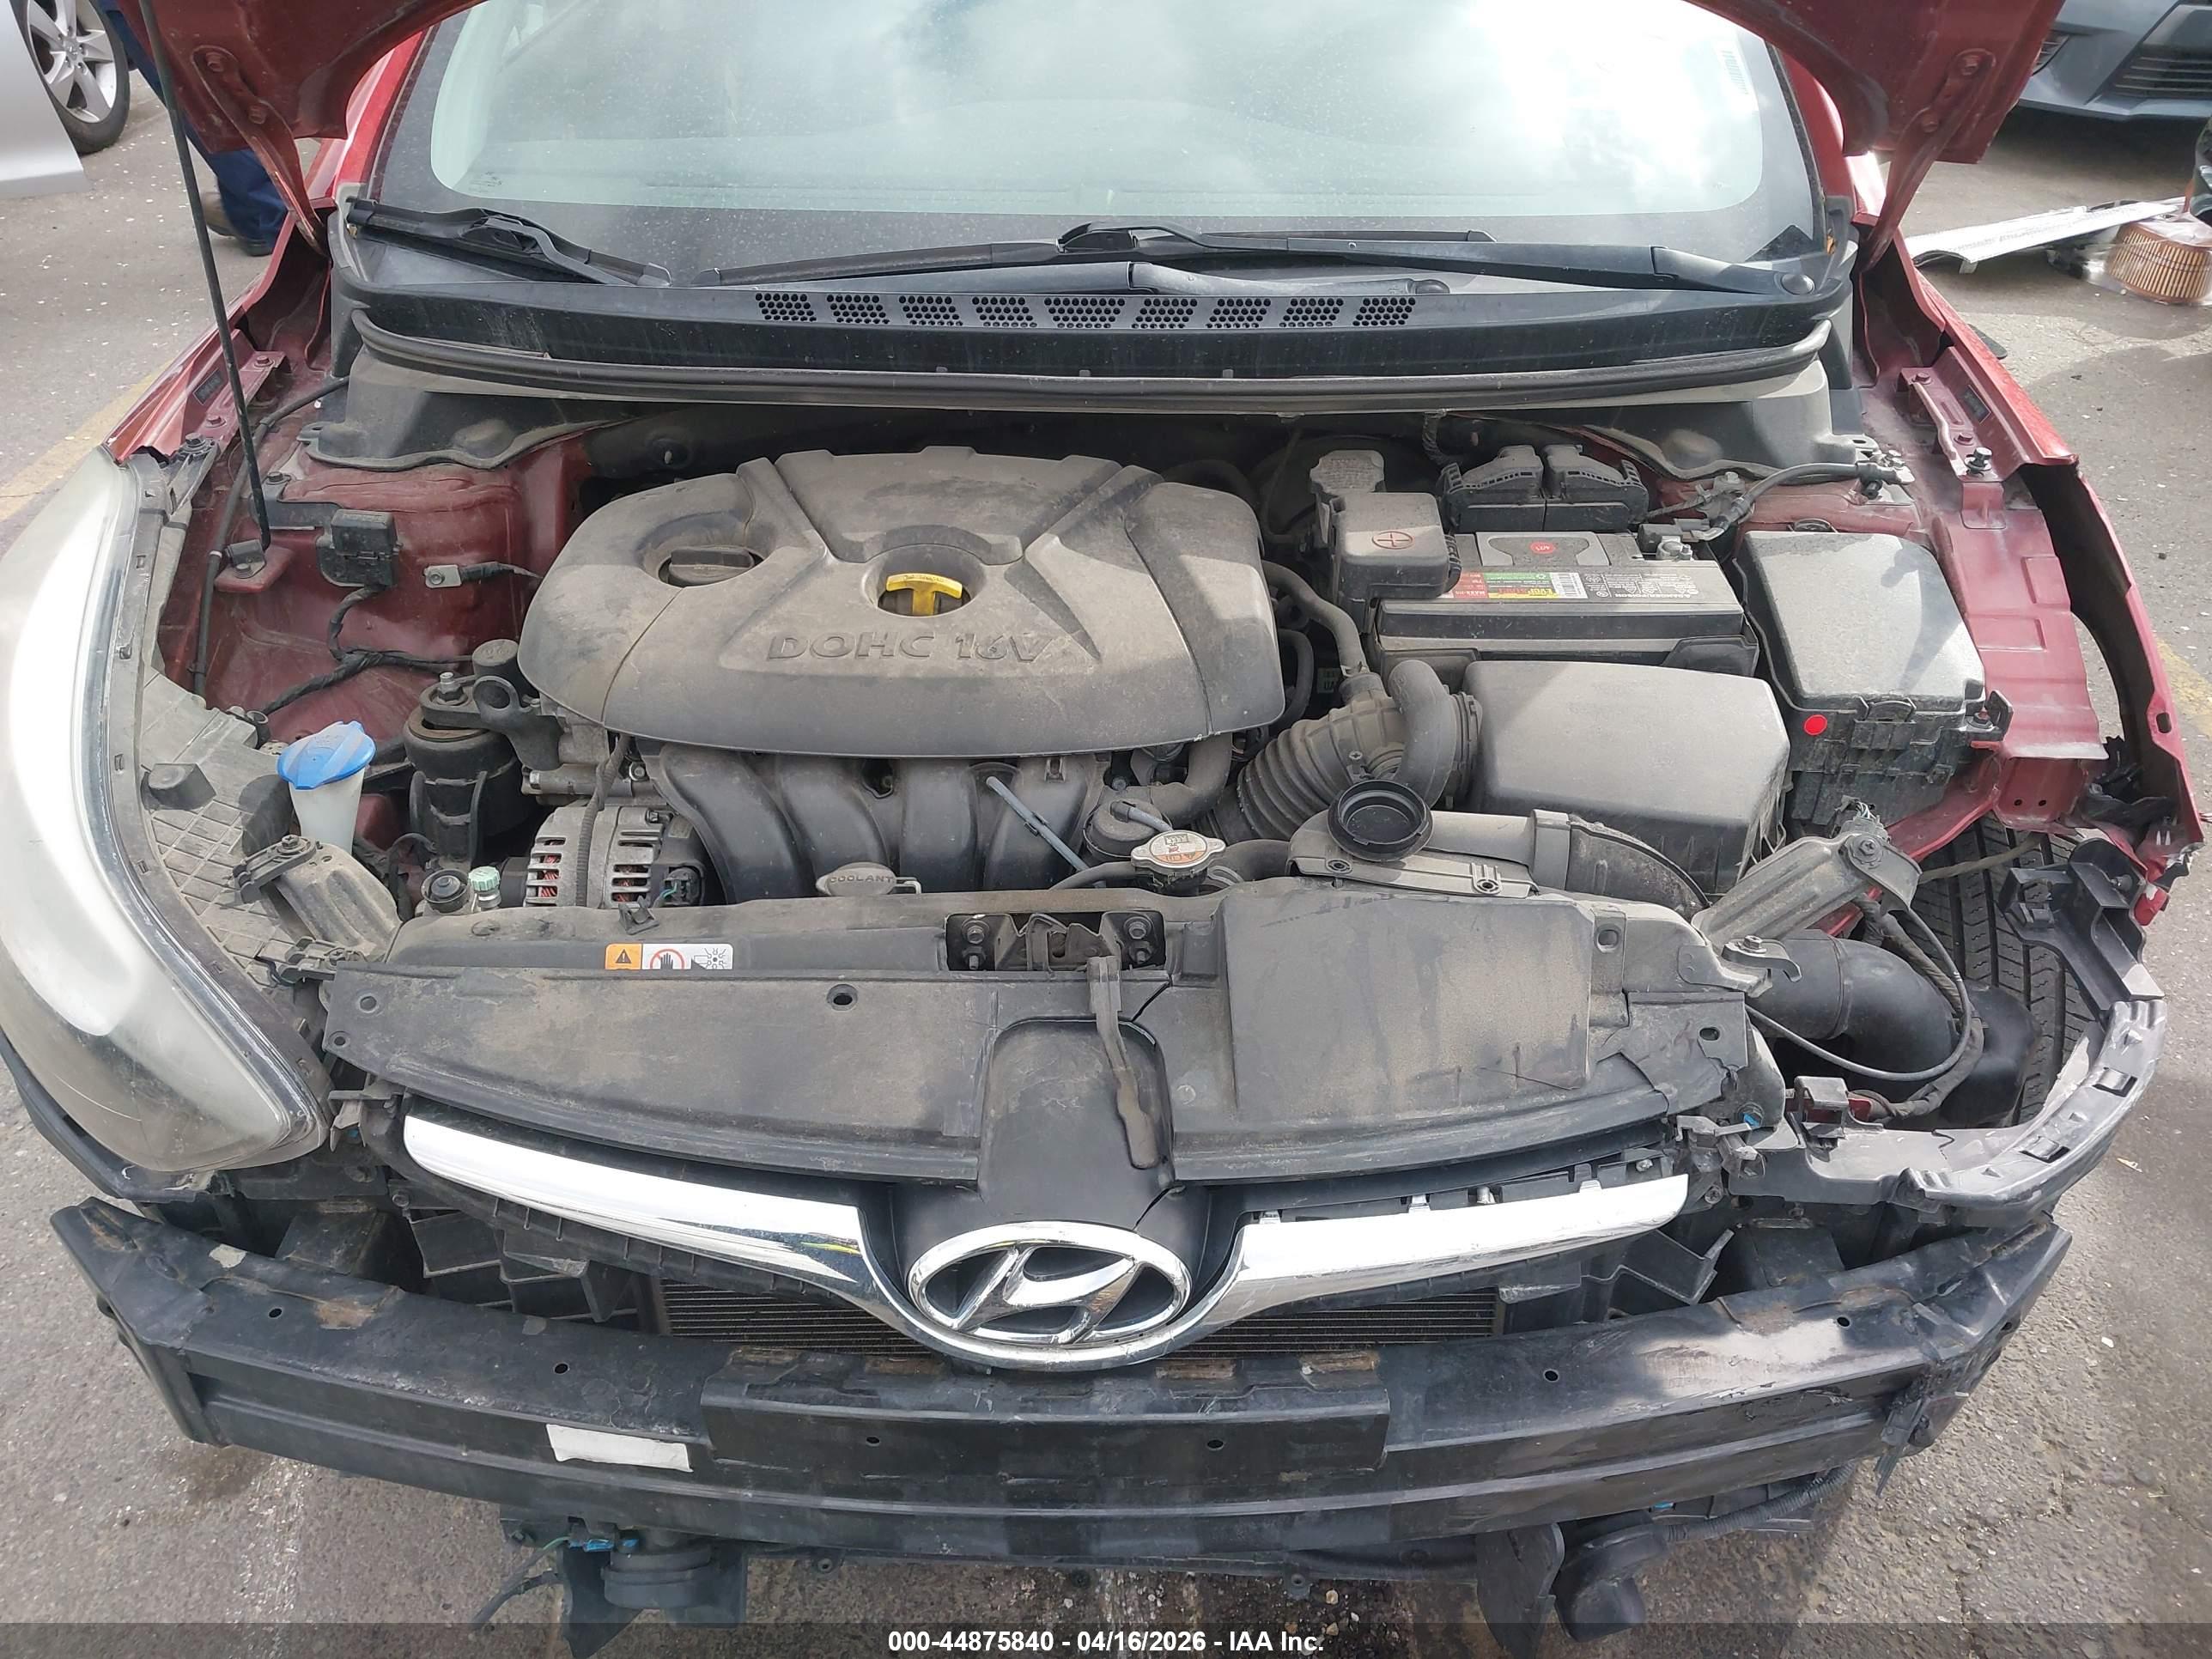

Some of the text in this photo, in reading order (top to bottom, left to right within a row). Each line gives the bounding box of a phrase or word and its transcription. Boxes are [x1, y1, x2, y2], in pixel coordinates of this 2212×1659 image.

[767, 631, 1054, 663] DOHC 16V
[830, 874, 894, 884] COOLANT
